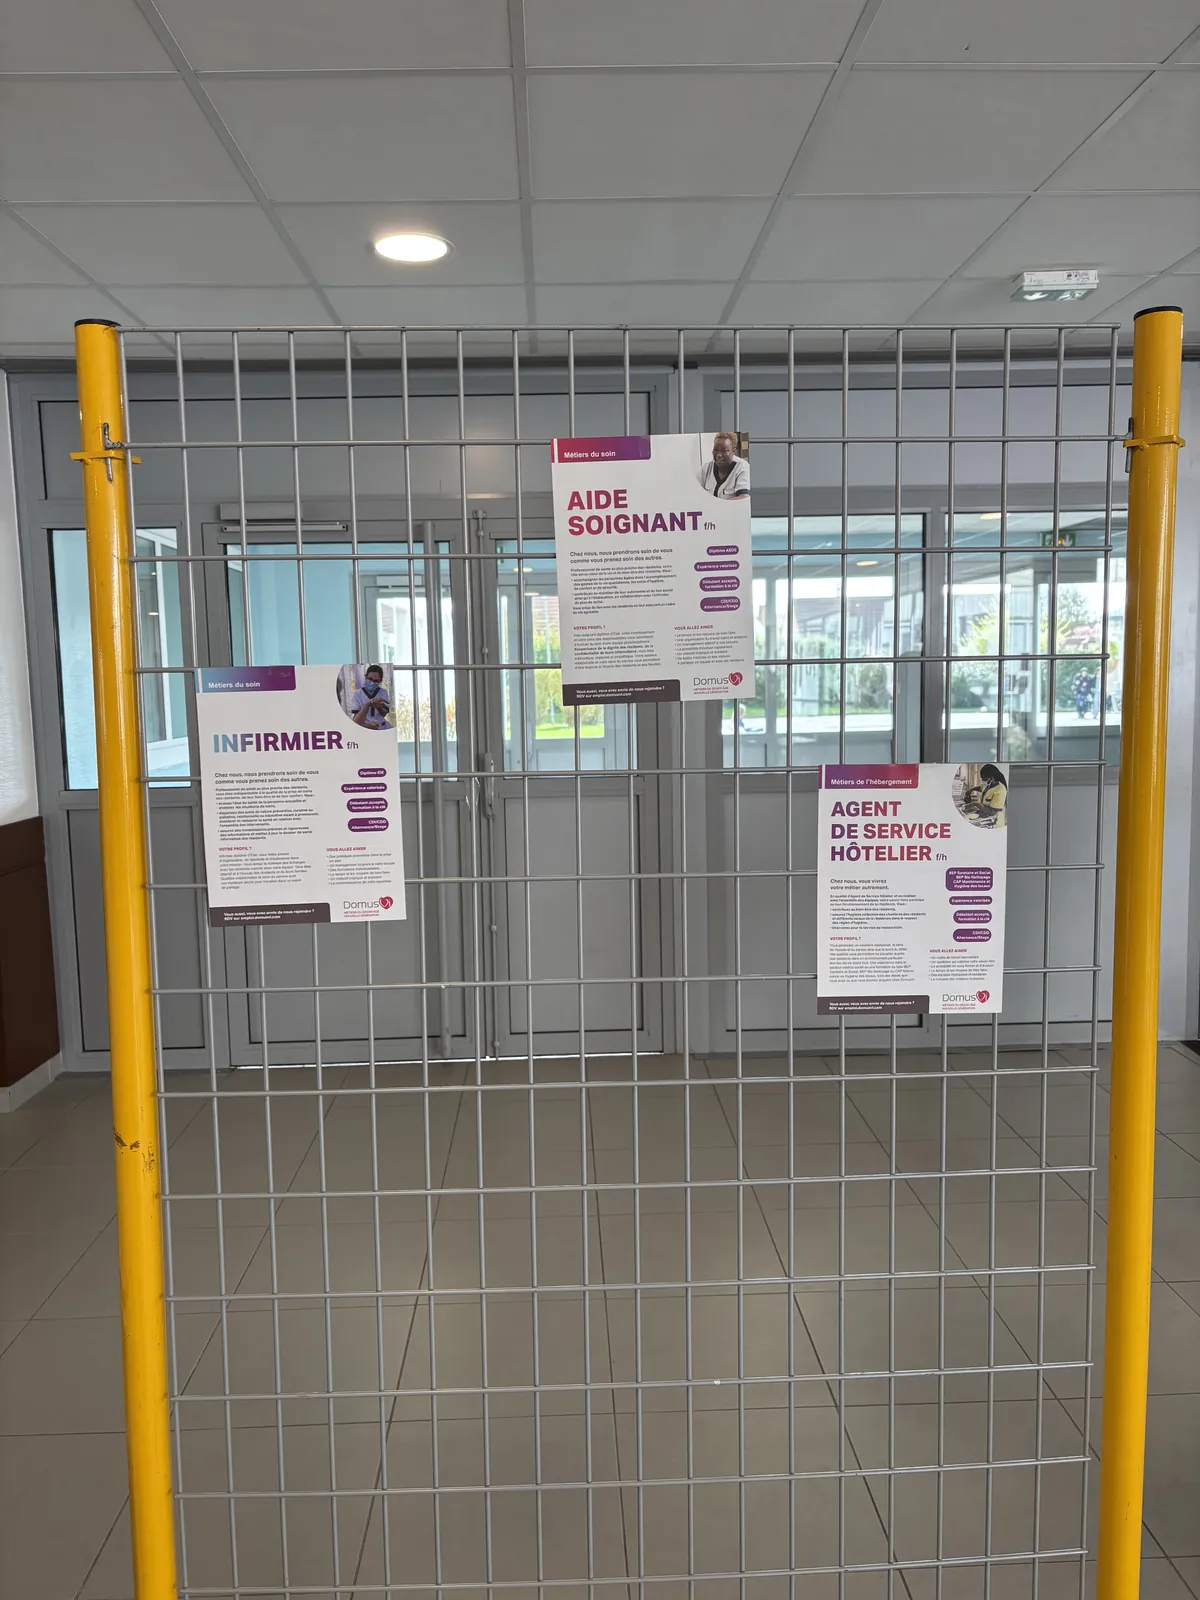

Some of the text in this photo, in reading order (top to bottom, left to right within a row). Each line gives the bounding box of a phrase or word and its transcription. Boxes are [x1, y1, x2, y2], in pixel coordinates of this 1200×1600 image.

[567, 489, 628, 510] AIDE
[568, 511, 716, 536] SOIGNANT f/h
[213, 731, 343, 753] INFIRMIER
[831, 801, 901, 817] AGENT
[831, 823, 951, 839] DE SERVICE
[831, 842, 931, 861] HÔTELIER
